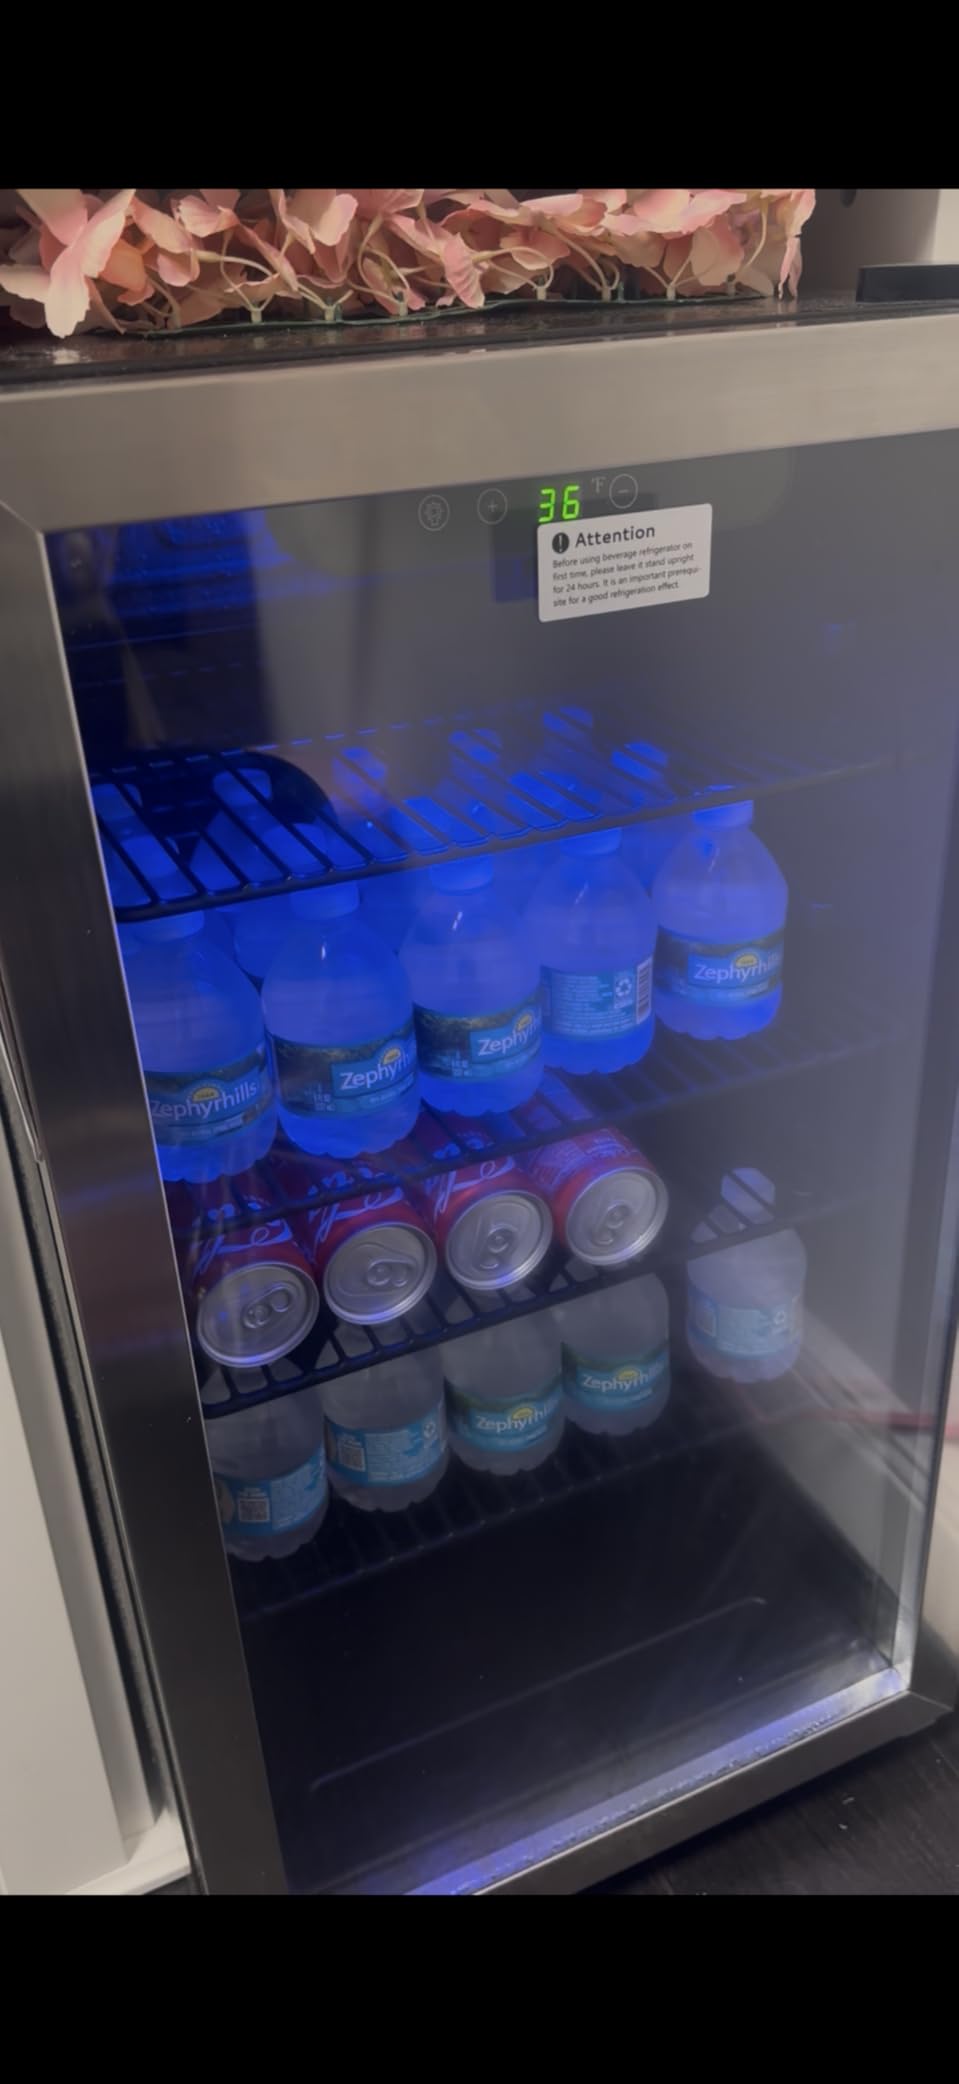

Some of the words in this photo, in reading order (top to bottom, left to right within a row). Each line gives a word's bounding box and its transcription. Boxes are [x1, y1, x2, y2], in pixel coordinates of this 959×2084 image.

[538, 485, 580, 523] 36
[575, 526, 656, 549] Attention
[553, 558, 578, 569] Before
[580, 555, 601, 565] using
[602, 551, 637, 562] beverage
[639, 543, 681, 556] refrigerator
[553, 571, 568, 581] first
[590, 566, 615, 577] please
[616, 563, 636, 571] leave
[637, 560, 643, 569] it
[645, 558, 666, 567] stand
[667, 553, 694, 565] upright
[553, 585, 564, 593] for
[566, 583, 575, 592] 24
[603, 578, 609, 587] It
[610, 578, 616, 586] is
[618, 576, 628, 584] an
[629, 570, 666, 583] important
[553, 597, 566, 607] site
[568, 595, 579, 604] for
[588, 592, 608, 604] good
[610, 583, 656, 598] refrigeration
[150, 1080, 257, 1121] Zephyrhills
